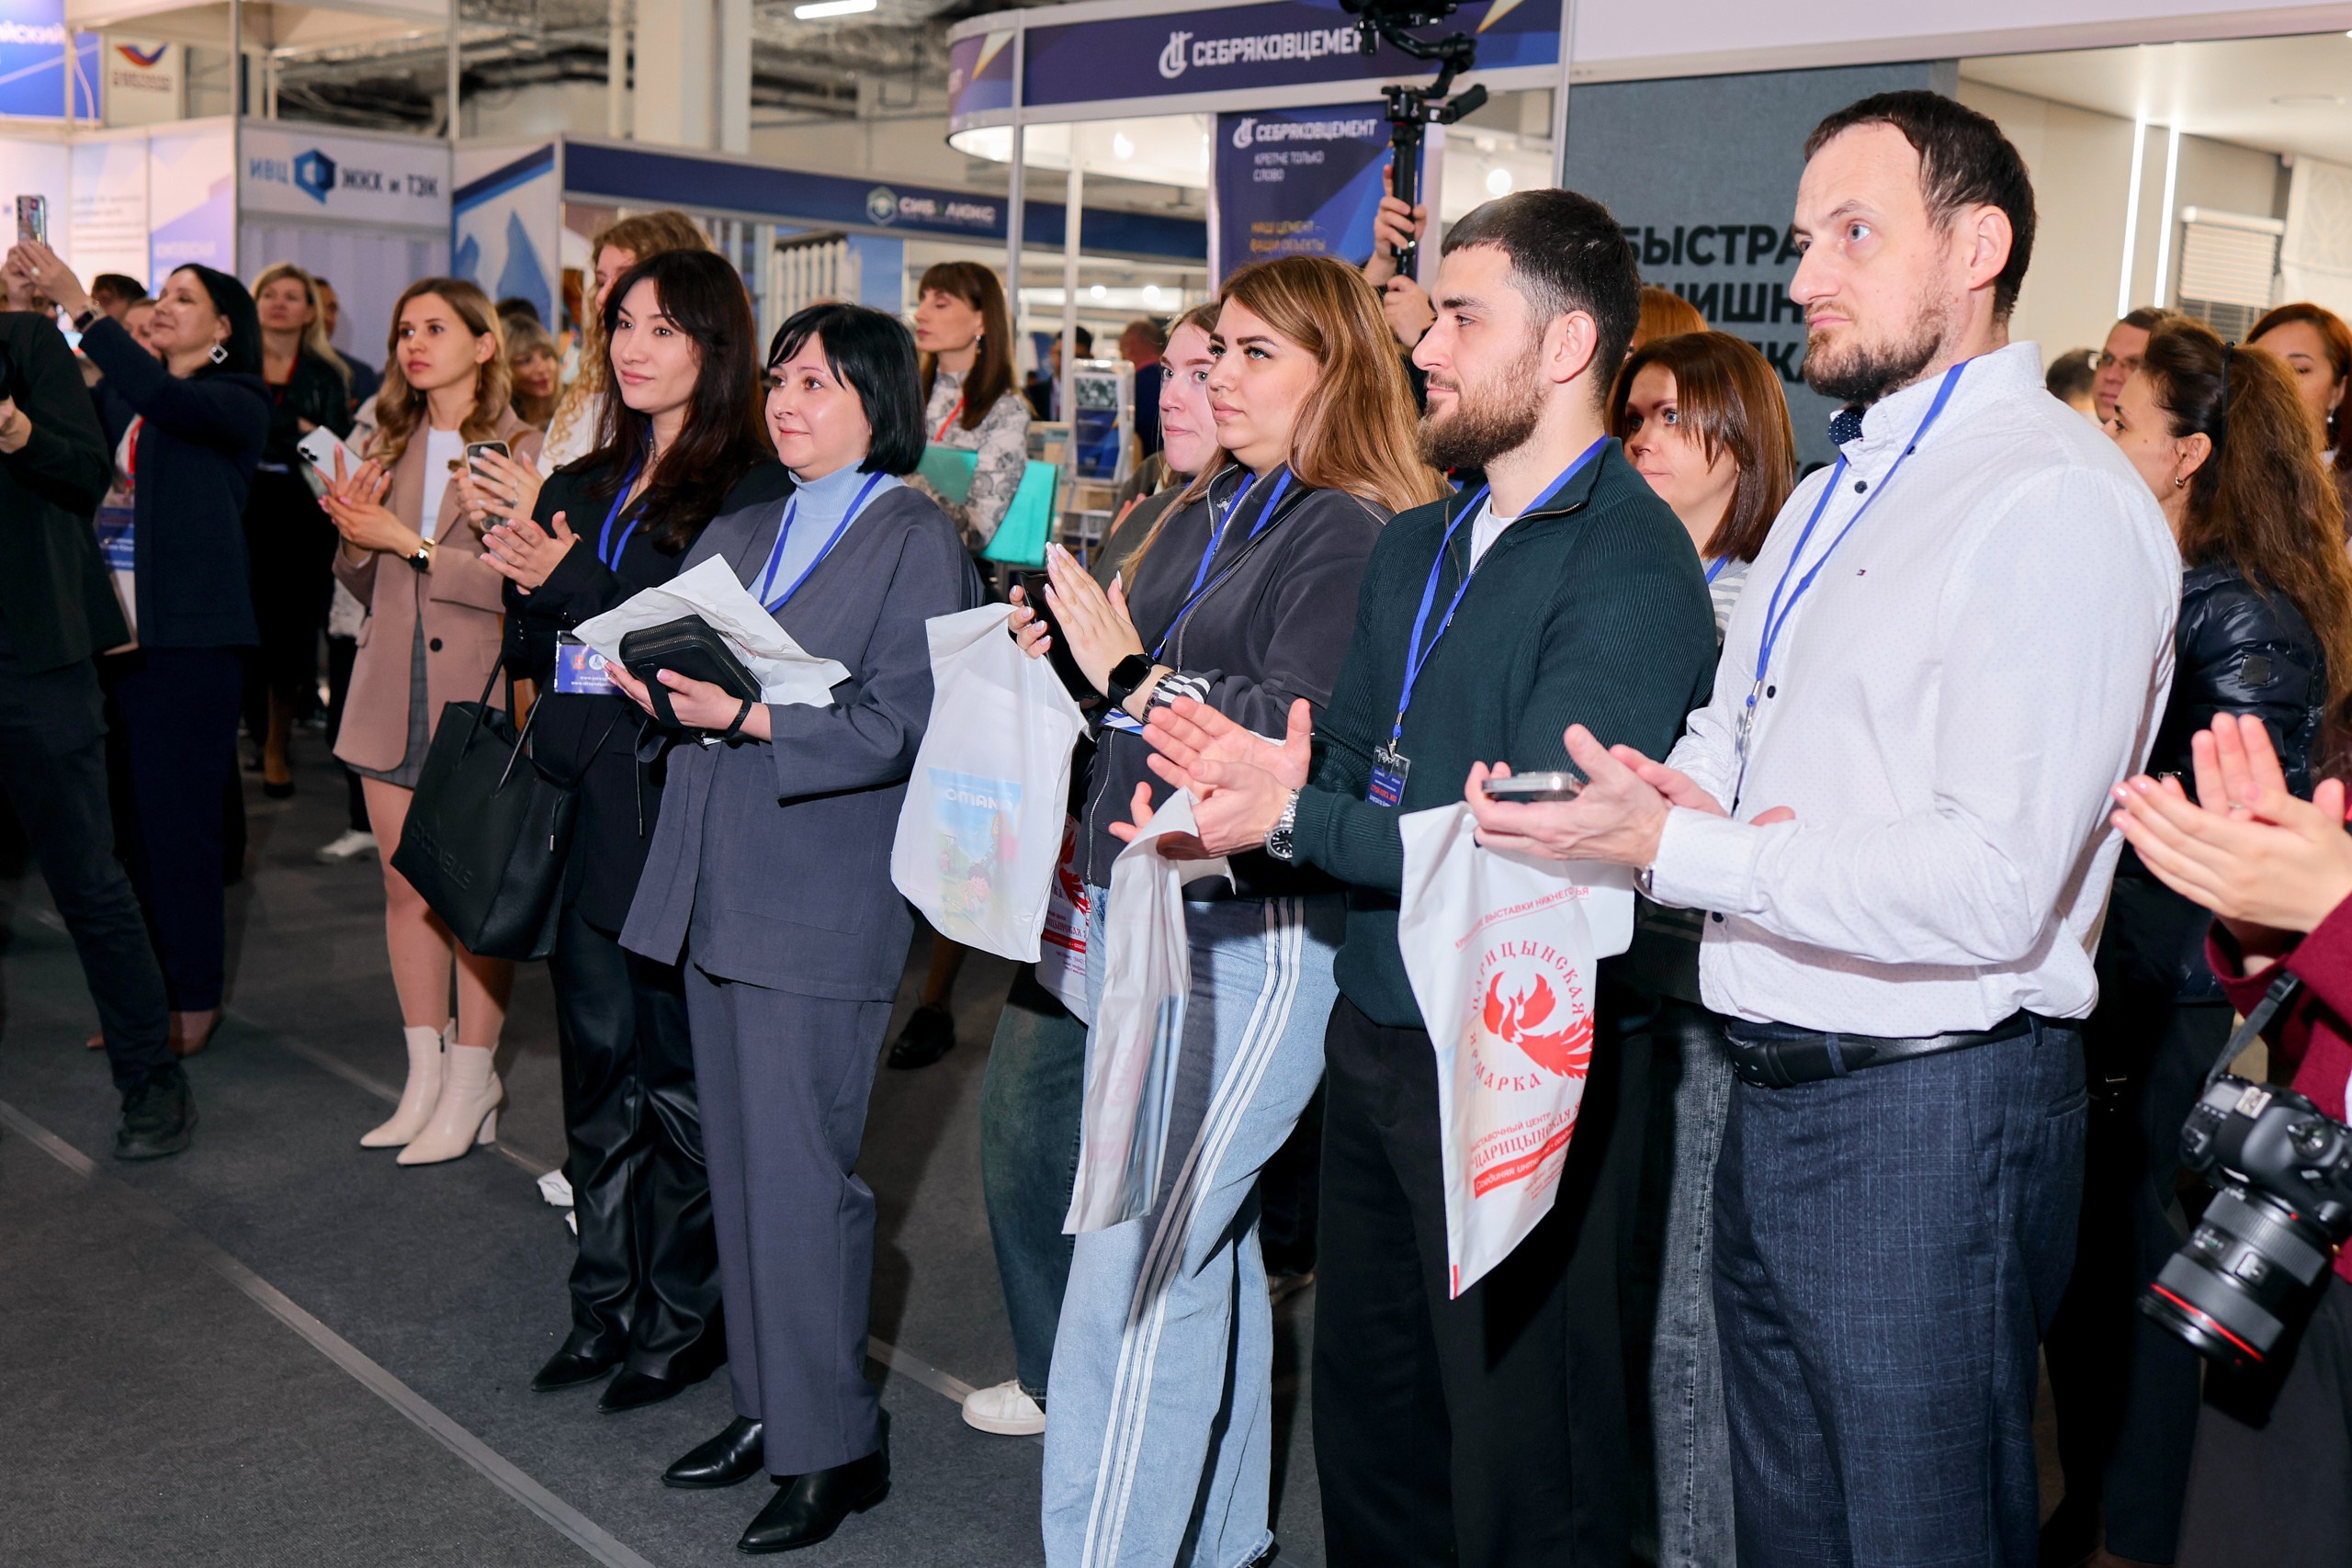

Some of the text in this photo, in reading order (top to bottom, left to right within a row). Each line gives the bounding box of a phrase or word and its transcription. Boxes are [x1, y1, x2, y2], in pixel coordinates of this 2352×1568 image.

[1193, 27, 1379, 67] СЕБРЯКОВЦЕМЕ
[1255, 118, 1377, 141] СЕБРЯКОВЦЕМЕНТ
[249, 157, 289, 184] ИВЦ
[342, 168, 383, 193] ЖКХ
[407, 174, 438, 197] ТЭК
[1253, 168, 1284, 182] СЛОВО
